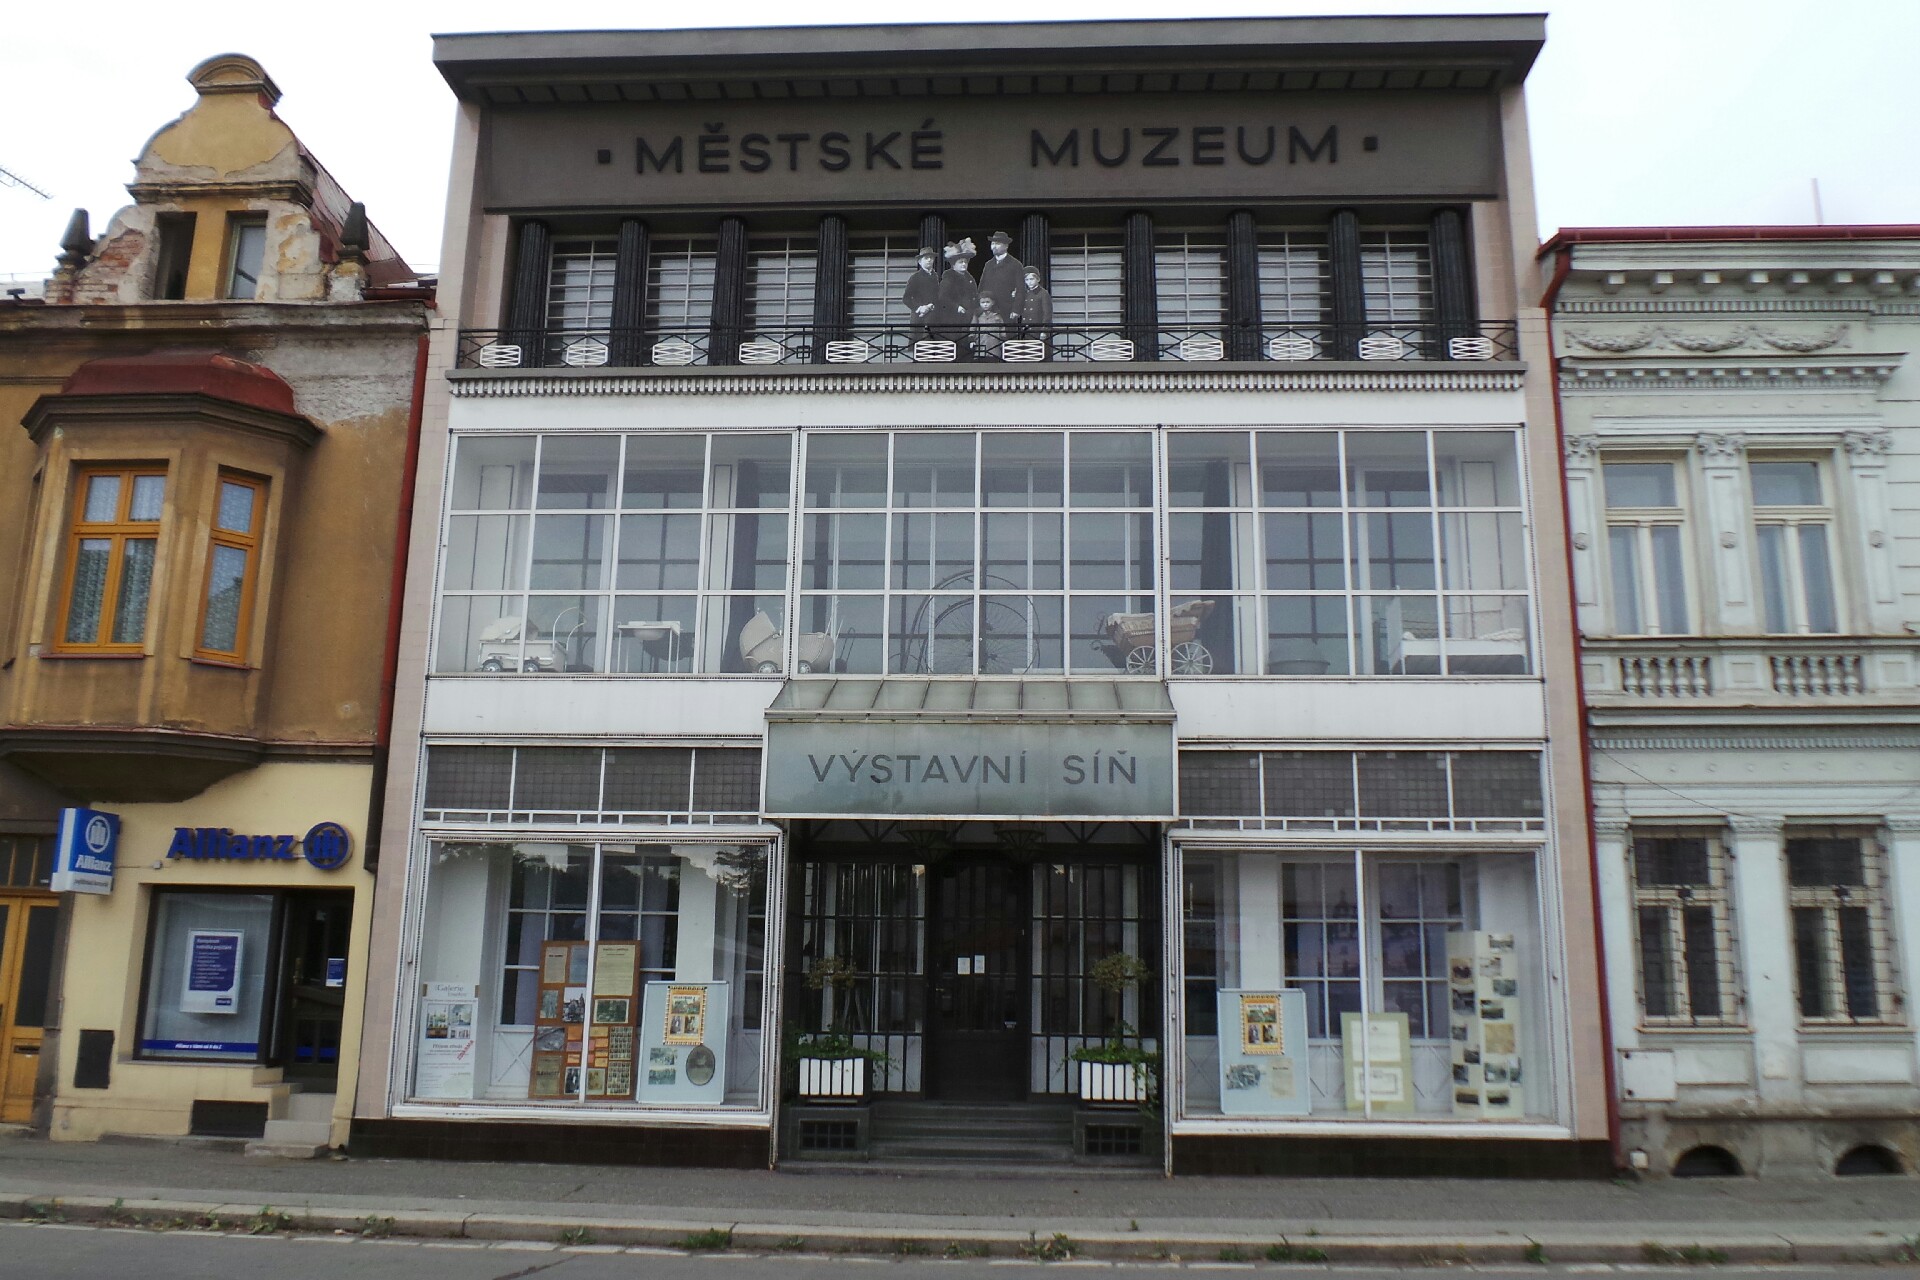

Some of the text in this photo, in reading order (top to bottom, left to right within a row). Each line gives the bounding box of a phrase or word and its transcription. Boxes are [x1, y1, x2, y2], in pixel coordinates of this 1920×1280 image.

[635, 119, 1340, 174] MĚSTSKÉ MUZEUM
[808, 749, 1137, 785] VÝSTAVNÍ SÍŇ
[166, 827, 295, 861] Allianz
[75, 854, 113, 872] Allianz
